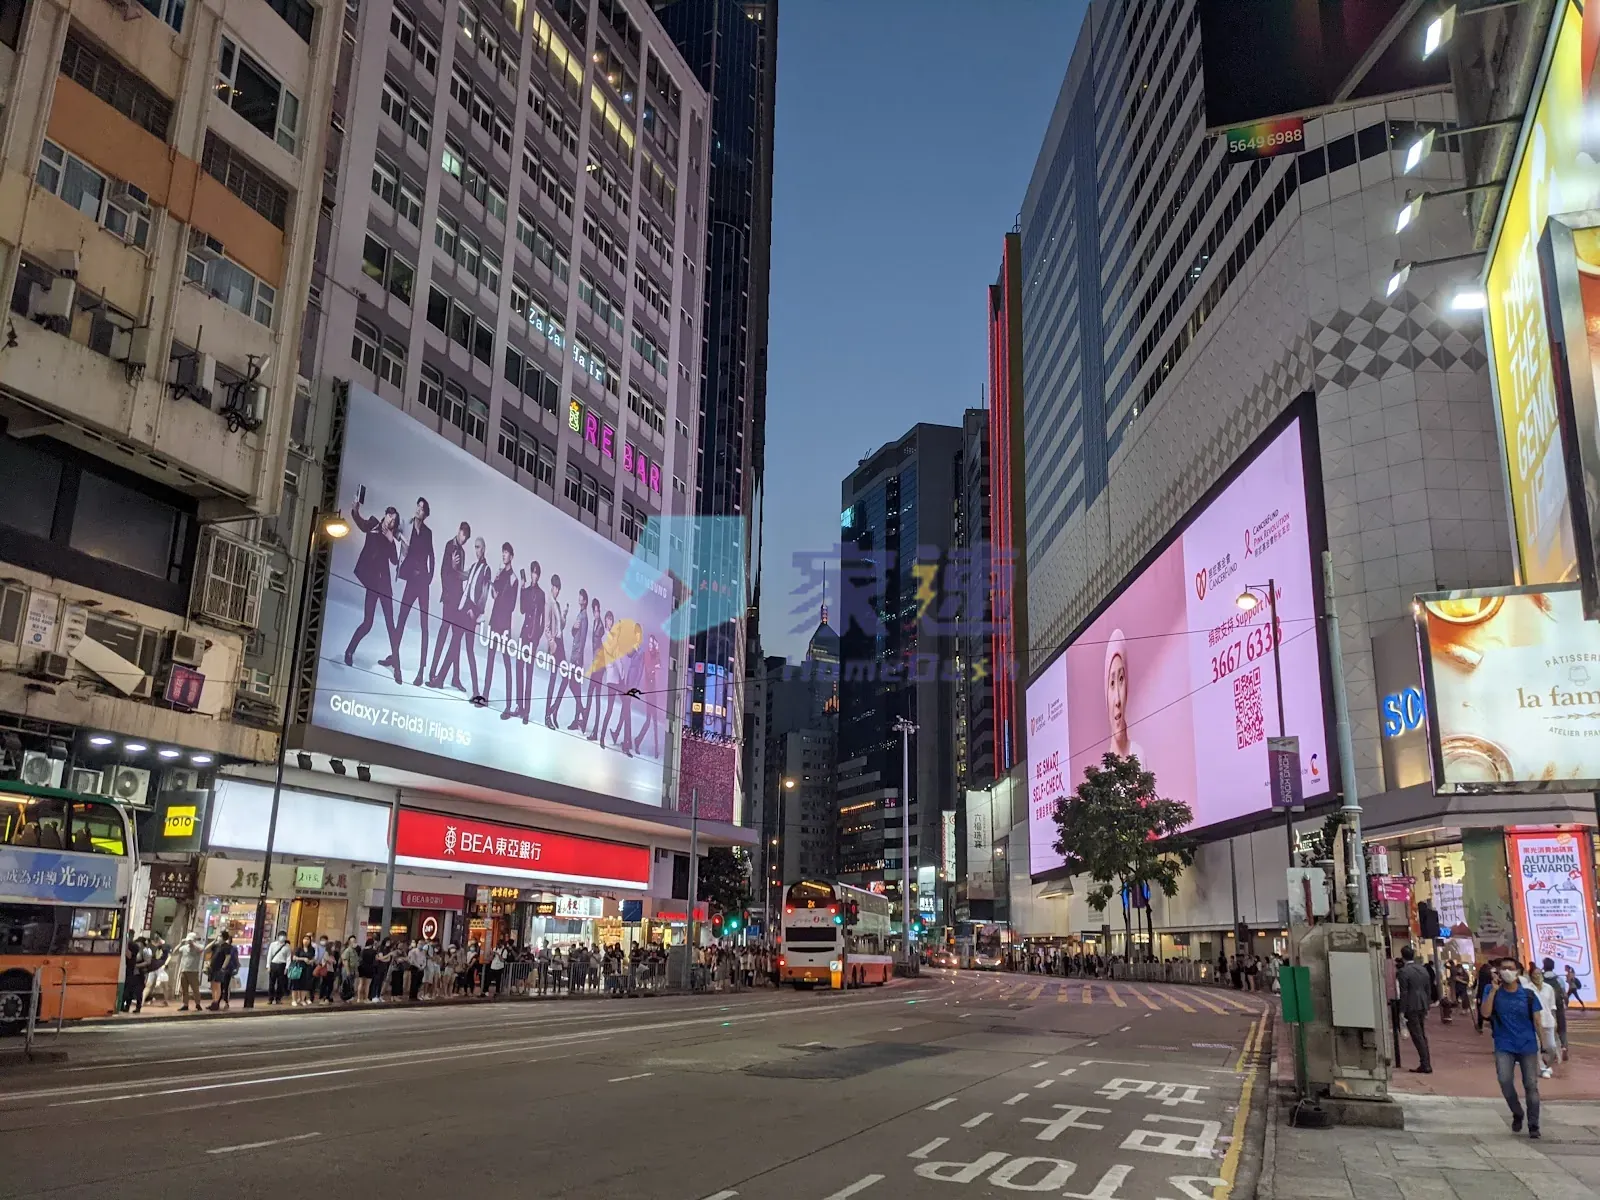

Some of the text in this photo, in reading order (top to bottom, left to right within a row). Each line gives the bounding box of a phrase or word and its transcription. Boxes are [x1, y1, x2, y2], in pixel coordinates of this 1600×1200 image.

[1229, 128, 1303, 153] 5649 6988
[1509, 308, 1539, 416] THE
[623, 442, 661, 494] BAR
[1235, 600, 1264, 627] Support
[479, 621, 584, 684] Unfold an era
[1211, 640, 1242, 683] 3667
[1517, 687, 1542, 709] la
[329, 694, 473, 746] Galaxy Z Fold3 Flip3 5G
[1042, 750, 1060, 773] SMART
[1283, 754, 1293, 803] HONG KONG
[460, 832, 542, 861] BEA 東亞銀行
[1524, 854, 1575, 864] AUTUMN
[1522, 863, 1579, 873] REWARDS
